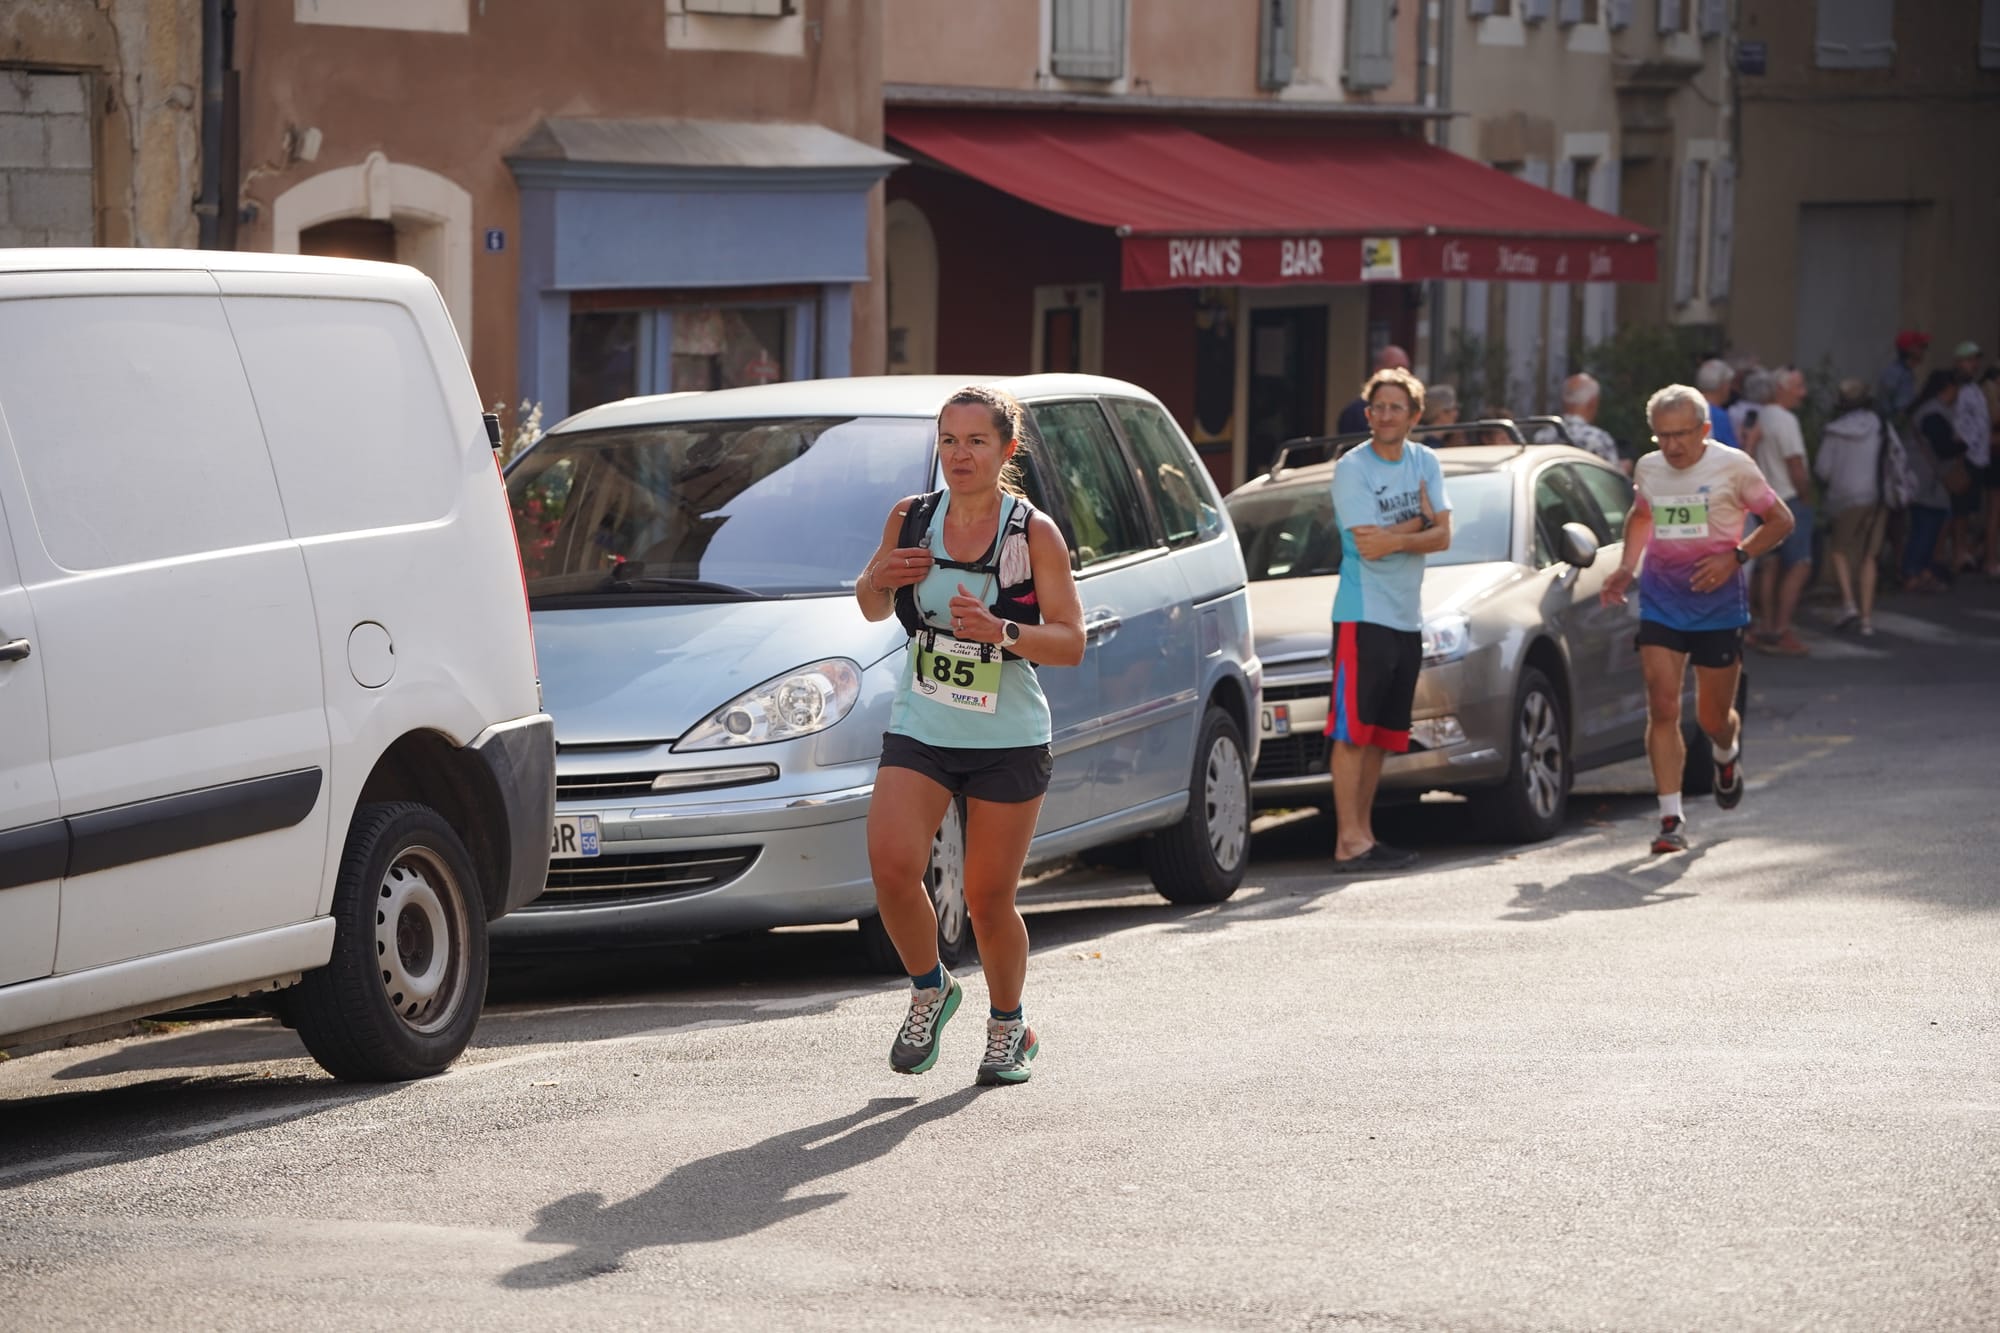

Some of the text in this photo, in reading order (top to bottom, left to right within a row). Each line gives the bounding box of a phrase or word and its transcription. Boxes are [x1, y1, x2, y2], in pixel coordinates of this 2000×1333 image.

[1168, 239, 1242, 278] RYAN'S
[1280, 239, 1323, 277] BAR
[1665, 507, 1691, 524] 79
[933, 655, 975, 687] 85
[951, 692, 979, 703] TUFF'S
[582, 836, 597, 850] 59
